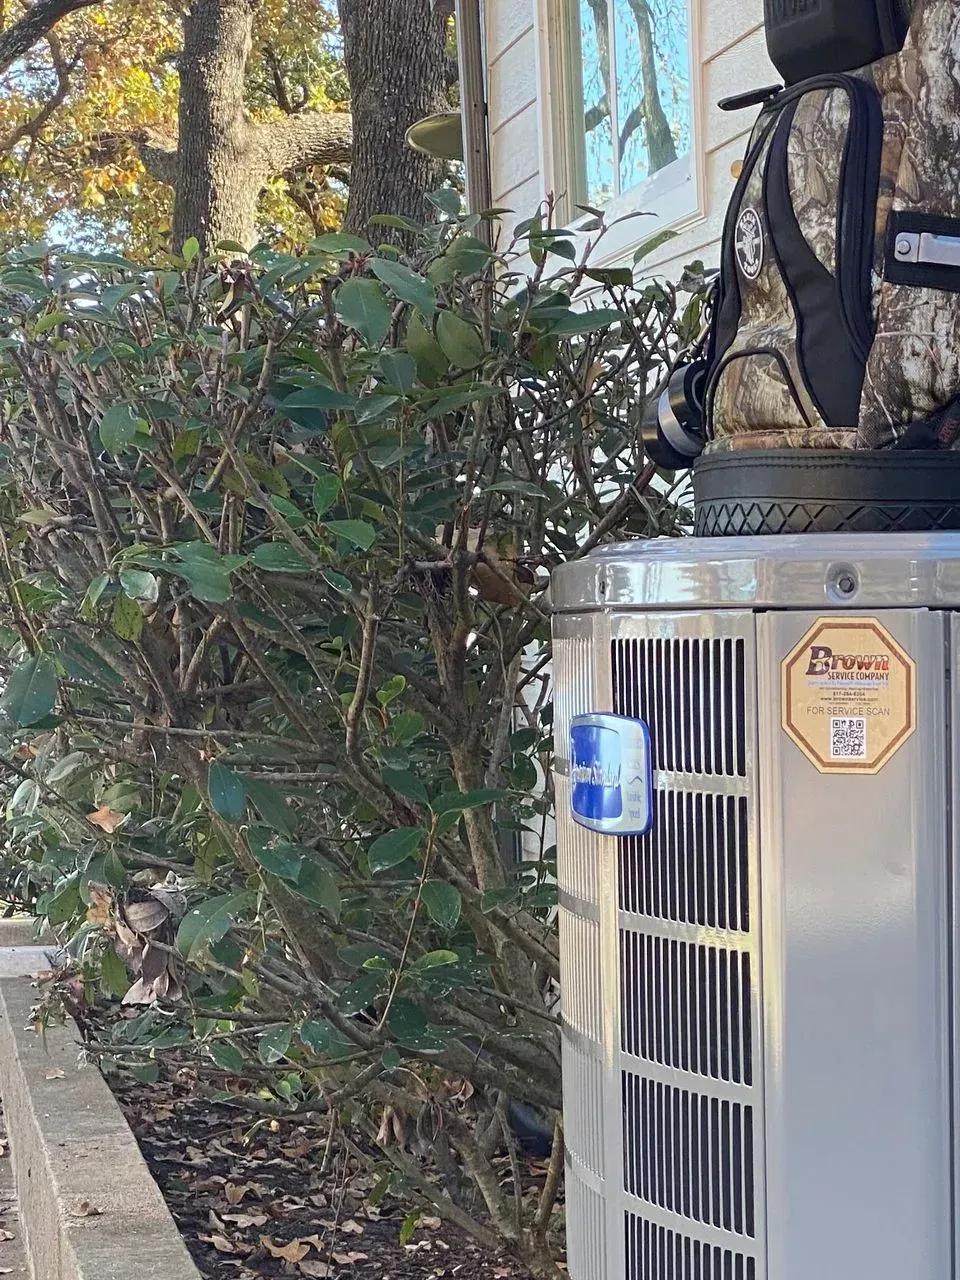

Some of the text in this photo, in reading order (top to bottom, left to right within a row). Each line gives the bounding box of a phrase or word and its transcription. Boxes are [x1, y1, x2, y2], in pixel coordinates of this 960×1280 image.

[805, 645, 890, 676] Brown
[827, 671, 890, 681] SERVICE COMPANY
[806, 706, 890, 716] FOR SERVICE SCAN
